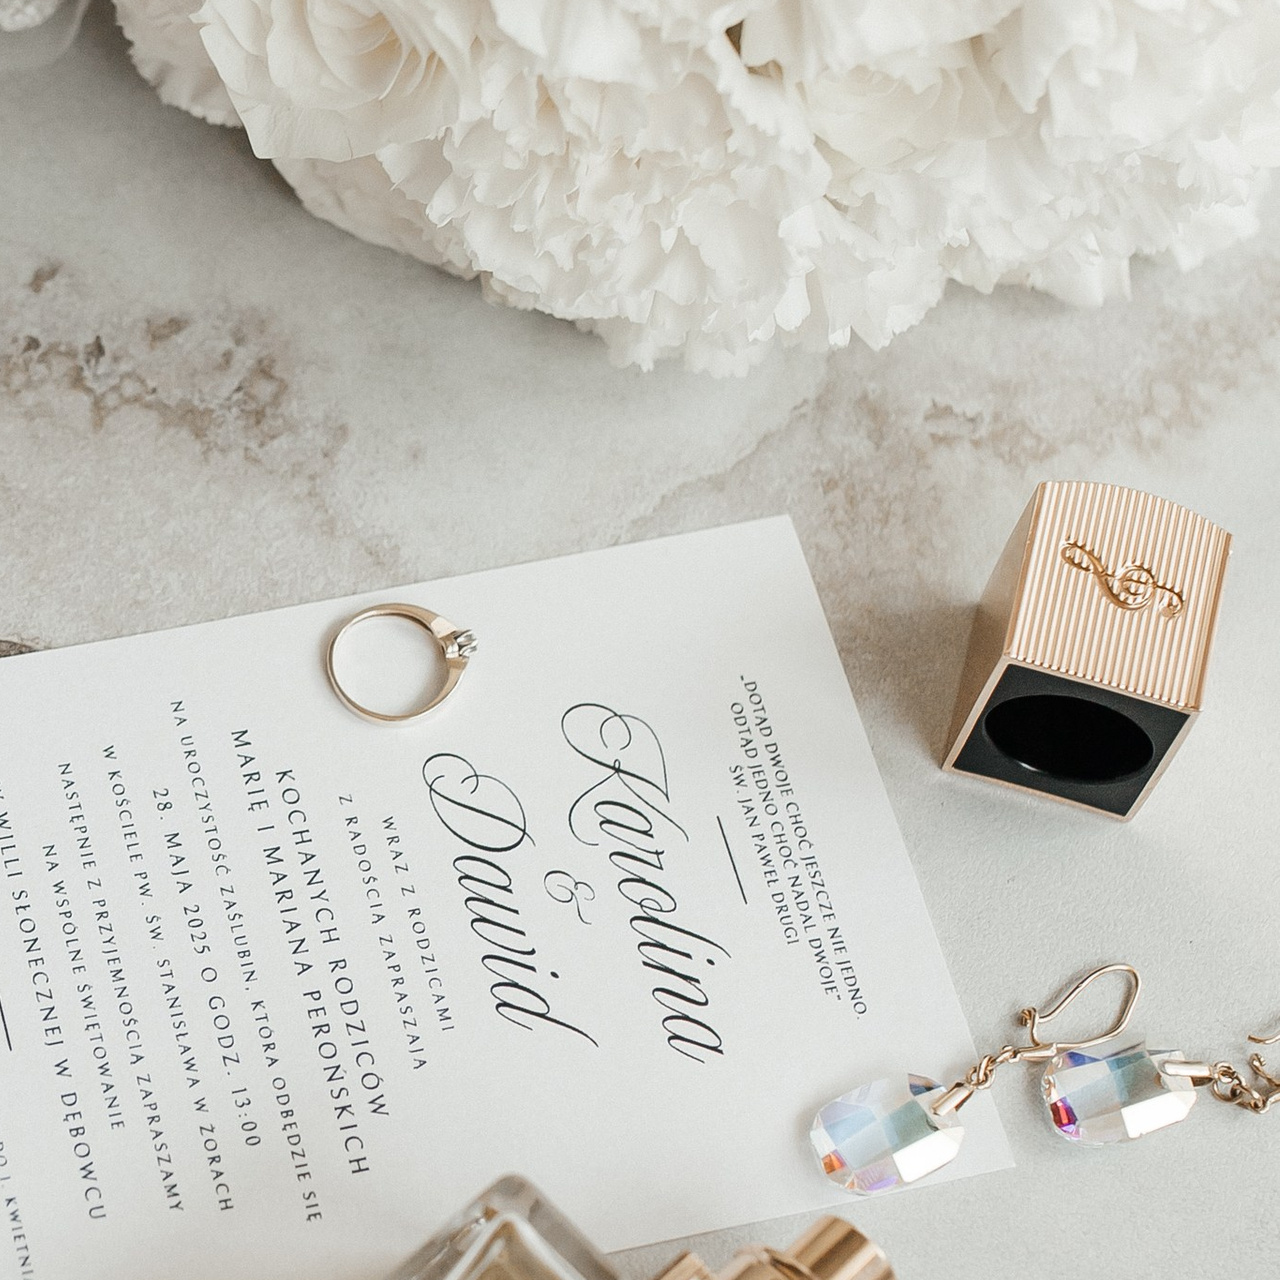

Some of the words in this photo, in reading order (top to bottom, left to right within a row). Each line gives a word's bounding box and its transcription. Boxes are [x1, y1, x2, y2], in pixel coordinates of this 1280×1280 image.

[101, 743, 119, 761] W
[229, 728, 271, 813] MARIĘ
[727, 763, 749, 795] ŚW.
[763, 740, 795, 798] DWOJE
[56, 761, 98, 871] NASTĘPNIE
[106, 769, 145, 864] KOŚCIELE
[151, 786, 174, 822] 28.
[255, 823, 276, 833] I
[337, 792, 354, 807] Z
[729, 700, 760, 760] ODTĄD
[745, 762, 780, 818] JEDNO
[769, 819, 800, 871] CHOĆ
[786, 873, 818, 935] NADAL
[735, 797, 762, 829] JAN
[784, 800, 816, 852] CHOĆ
[162, 830, 195, 895] MAJA
[343, 814, 387, 926] RADOŚCIĄ
[380, 814, 410, 876] WRAZ
[750, 831, 781, 889] PAWEŁ
[85, 876, 103, 891] Z
[132, 870, 155, 907] PW.
[261, 844, 315, 978] MARIANA
[399, 883, 417, 898] Z
[420, 751, 601, 1049] Dawid
[542, 868, 597, 927] &
[559, 701, 733, 1066] Karolina
[798, 854, 838, 924] JESZCZE
[144, 913, 166, 951] ŚW.
[181, 903, 212, 956] 2025
[274, 768, 342, 945] KOCHANYCH
[327, 956, 391, 1117] RODZICÓW
[769, 890, 801, 946] DRUGI
[825, 925, 849, 957] NIE
[10, 888, 65, 1048] SŁONECZNEJ
[40, 843, 61, 873] NA
[51, 878, 88, 976] WSPÓLNE
[75, 982, 127, 1131] ŚWIĘTOWANIE
[91, 897, 147, 1067] PRZYJEMNOŚCIĄ
[169, 699, 189, 728] NA
[179, 734, 233, 878] UROCZYSTOŚĆ
[249, 998, 281, 1069] KTÓRA
[270, 1075, 313, 1183] ODBĘDZIE
[301, 1189, 324, 1223] SIĘ
[199, 965, 219, 984] O
[406, 906, 456, 1033] RODZICAMI
[155, 957, 202, 1090] STANISŁAWA
[377, 933, 429, 1071] ZAPRASZAJĄ
[52, 1057, 74, 1079] W
[207, 994, 242, 1077] GODZ.
[192, 1095, 210, 1114] W
[301, 988, 371, 1176] PEROŃSKICH
[135, 1072, 186, 1212] ZAPRASZAMY
[230, 1086, 263, 1148] 13:00
[59, 1090, 108, 1221] DĘBOWCU
[197, 1122, 236, 1213] ŻORACH
